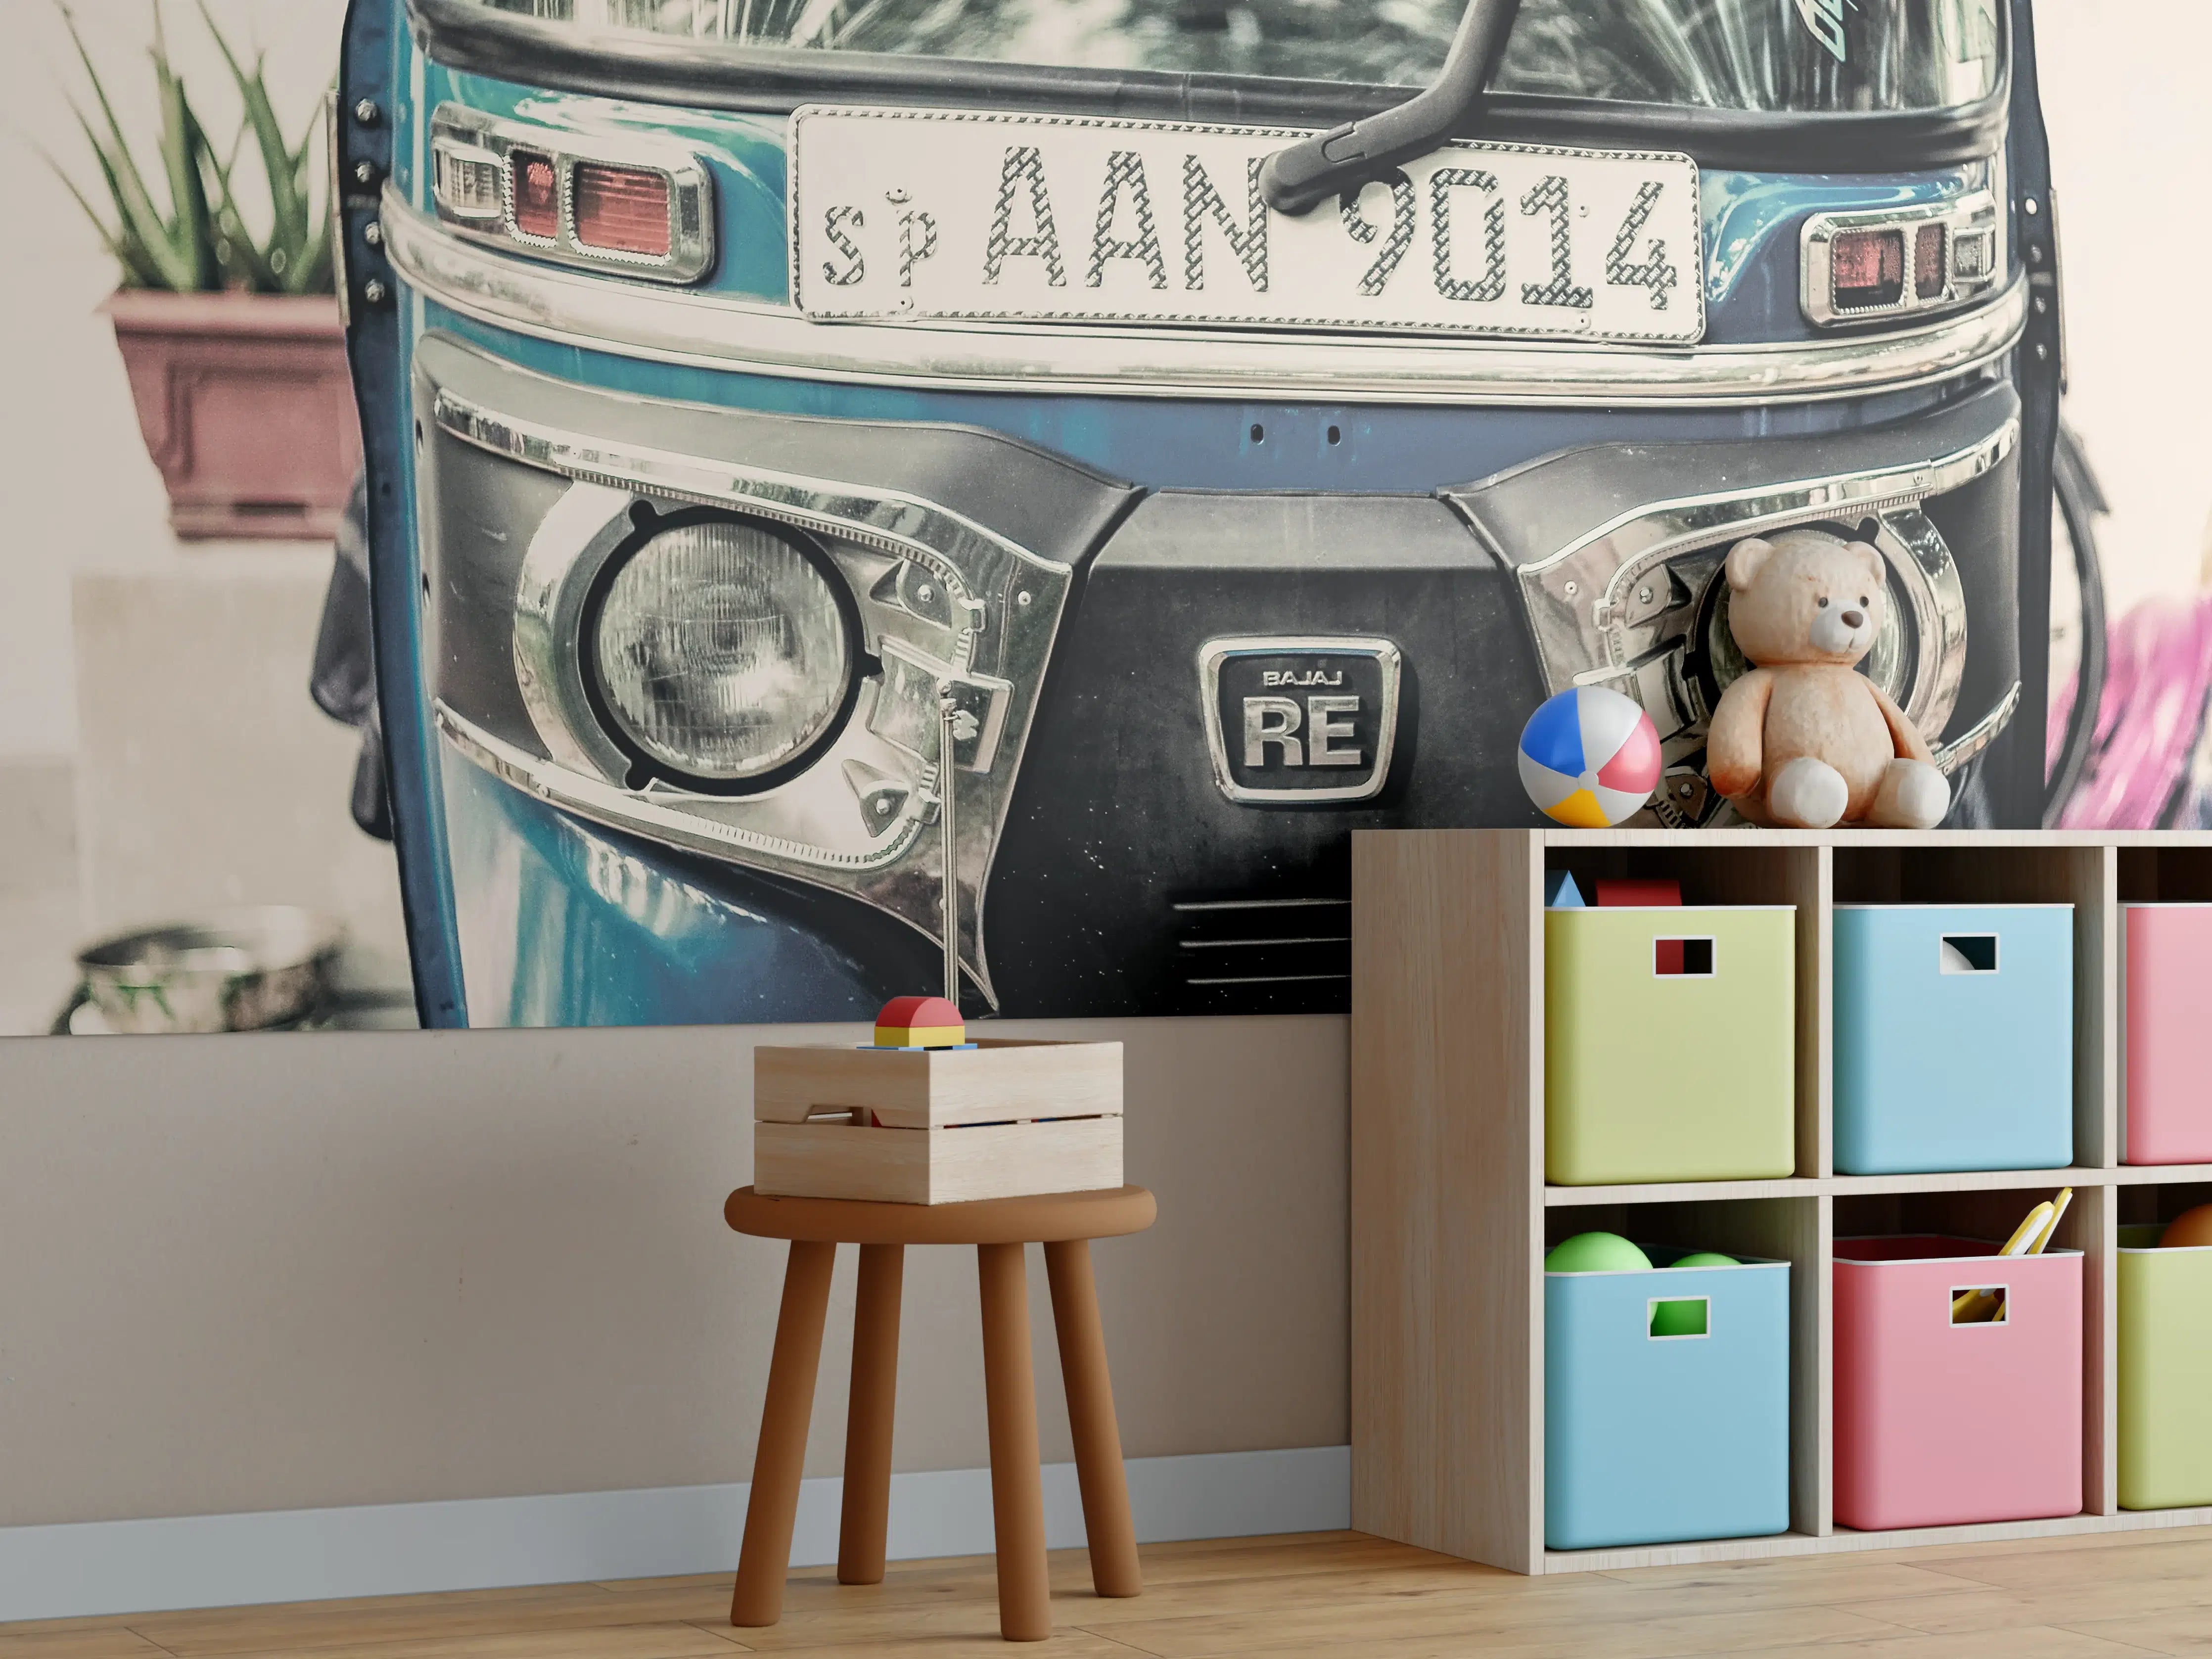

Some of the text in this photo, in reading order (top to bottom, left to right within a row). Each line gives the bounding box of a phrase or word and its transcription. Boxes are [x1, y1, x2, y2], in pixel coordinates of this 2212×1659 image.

[822, 146, 1677, 310] SP AAN 9014
[1263, 670, 1342, 686] BAJAJ
[1243, 695, 1362, 766] RE
